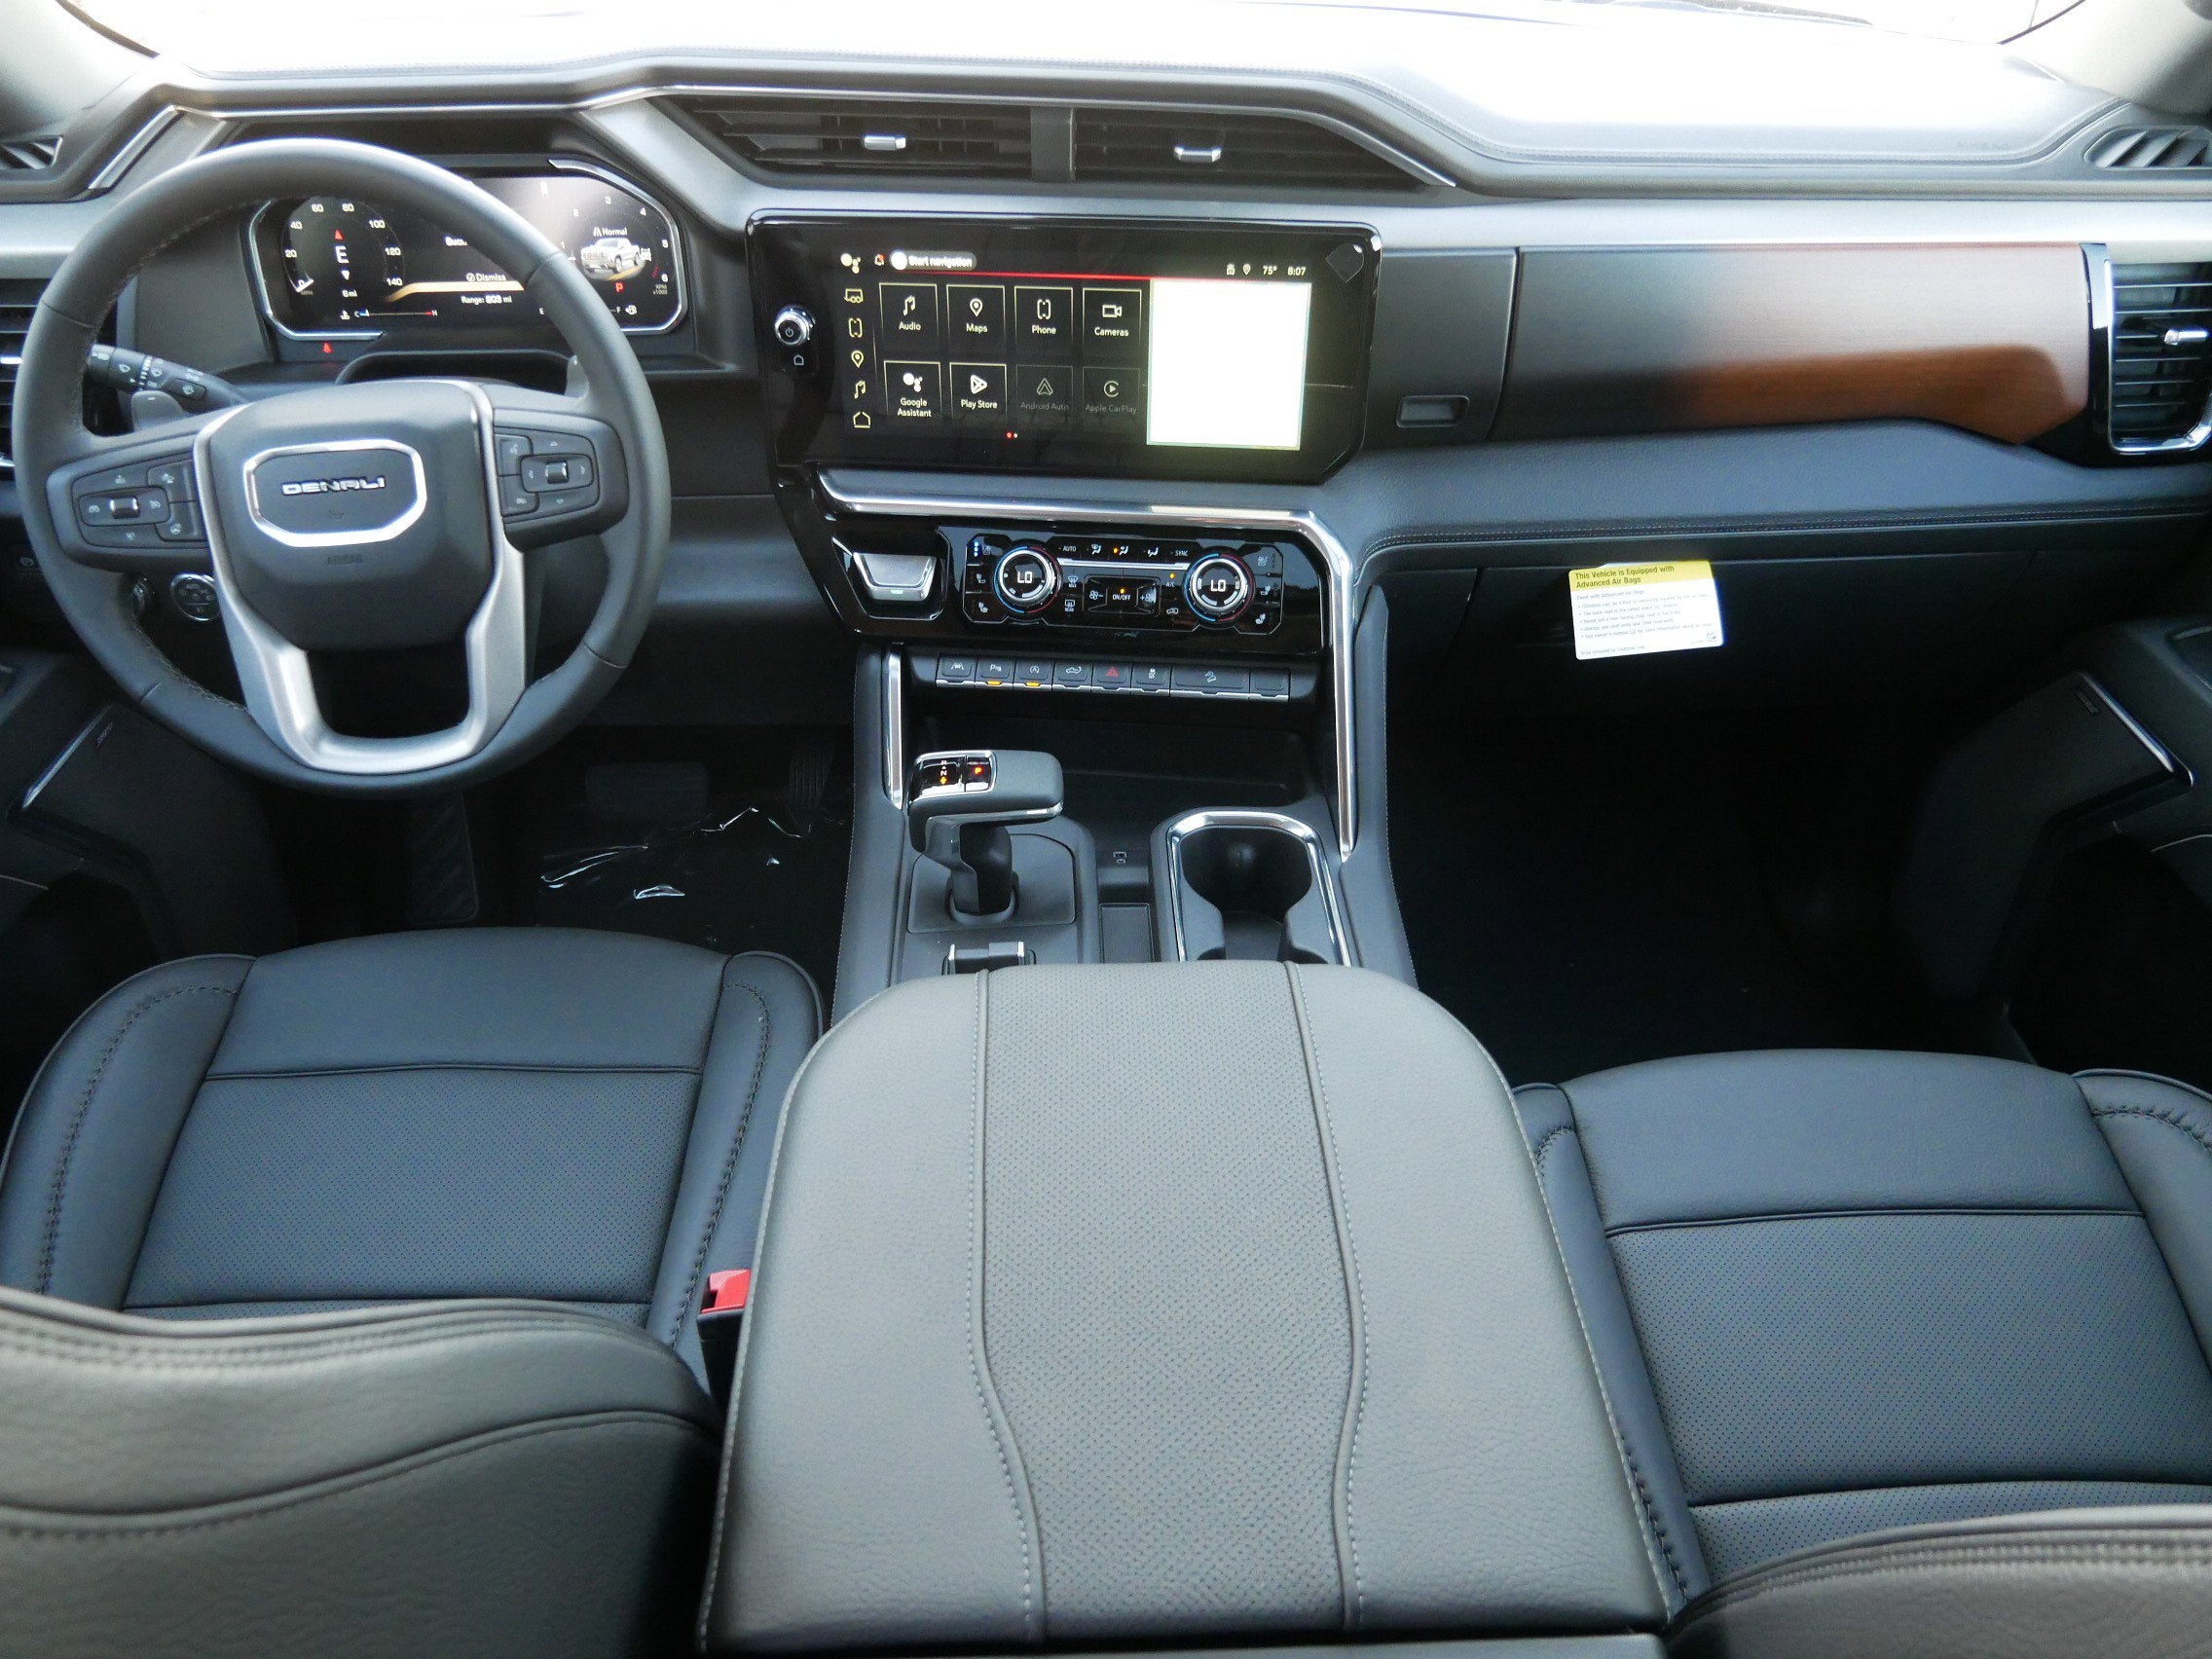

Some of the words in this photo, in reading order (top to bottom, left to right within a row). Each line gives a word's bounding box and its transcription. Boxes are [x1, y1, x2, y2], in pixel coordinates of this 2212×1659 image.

[312, 203, 323, 212] 60
[342, 203, 354, 212] 80
[573, 208, 579, 217] 2
[640, 207, 646, 216] 4
[290, 221, 302, 230] 40
[369, 220, 385, 229] 100
[285, 249, 297, 258] 20
[335, 245, 350, 263] E
[908, 255, 929, 266] Start
[930, 257, 972, 269] navigation
[1263, 265, 1277, 275] 75°
[1287, 266, 1307, 276] 8:07
[387, 277, 402, 286] 140
[661, 274, 668, 282] 6
[615, 282, 624, 292] P
[461, 296, 485, 305] Range:
[899, 321, 921, 331] Audio
[966, 323, 988, 334] Maps
[1032, 325, 1056, 335] Phone
[1094, 326, 1128, 337] Cameras
[901, 397, 927, 408] Google
[961, 399, 976, 409] Play
[977, 400, 997, 409] Store
[898, 408, 932, 417] Assistant
[1085, 404, 1106, 413] Apple
[1109, 405, 1137, 415] CarPlay
[282, 475, 386, 496] DENALI
[1591, 570, 1616, 578] Vehicle
[1626, 567, 1658, 576] Equipped
[1659, 565, 1675, 573] with
[1017, 571, 1032, 583] LO
[1211, 579, 1226, 592] LO
[1576, 579, 1610, 589] Advanced
[1624, 576, 1641, 585] Bags
